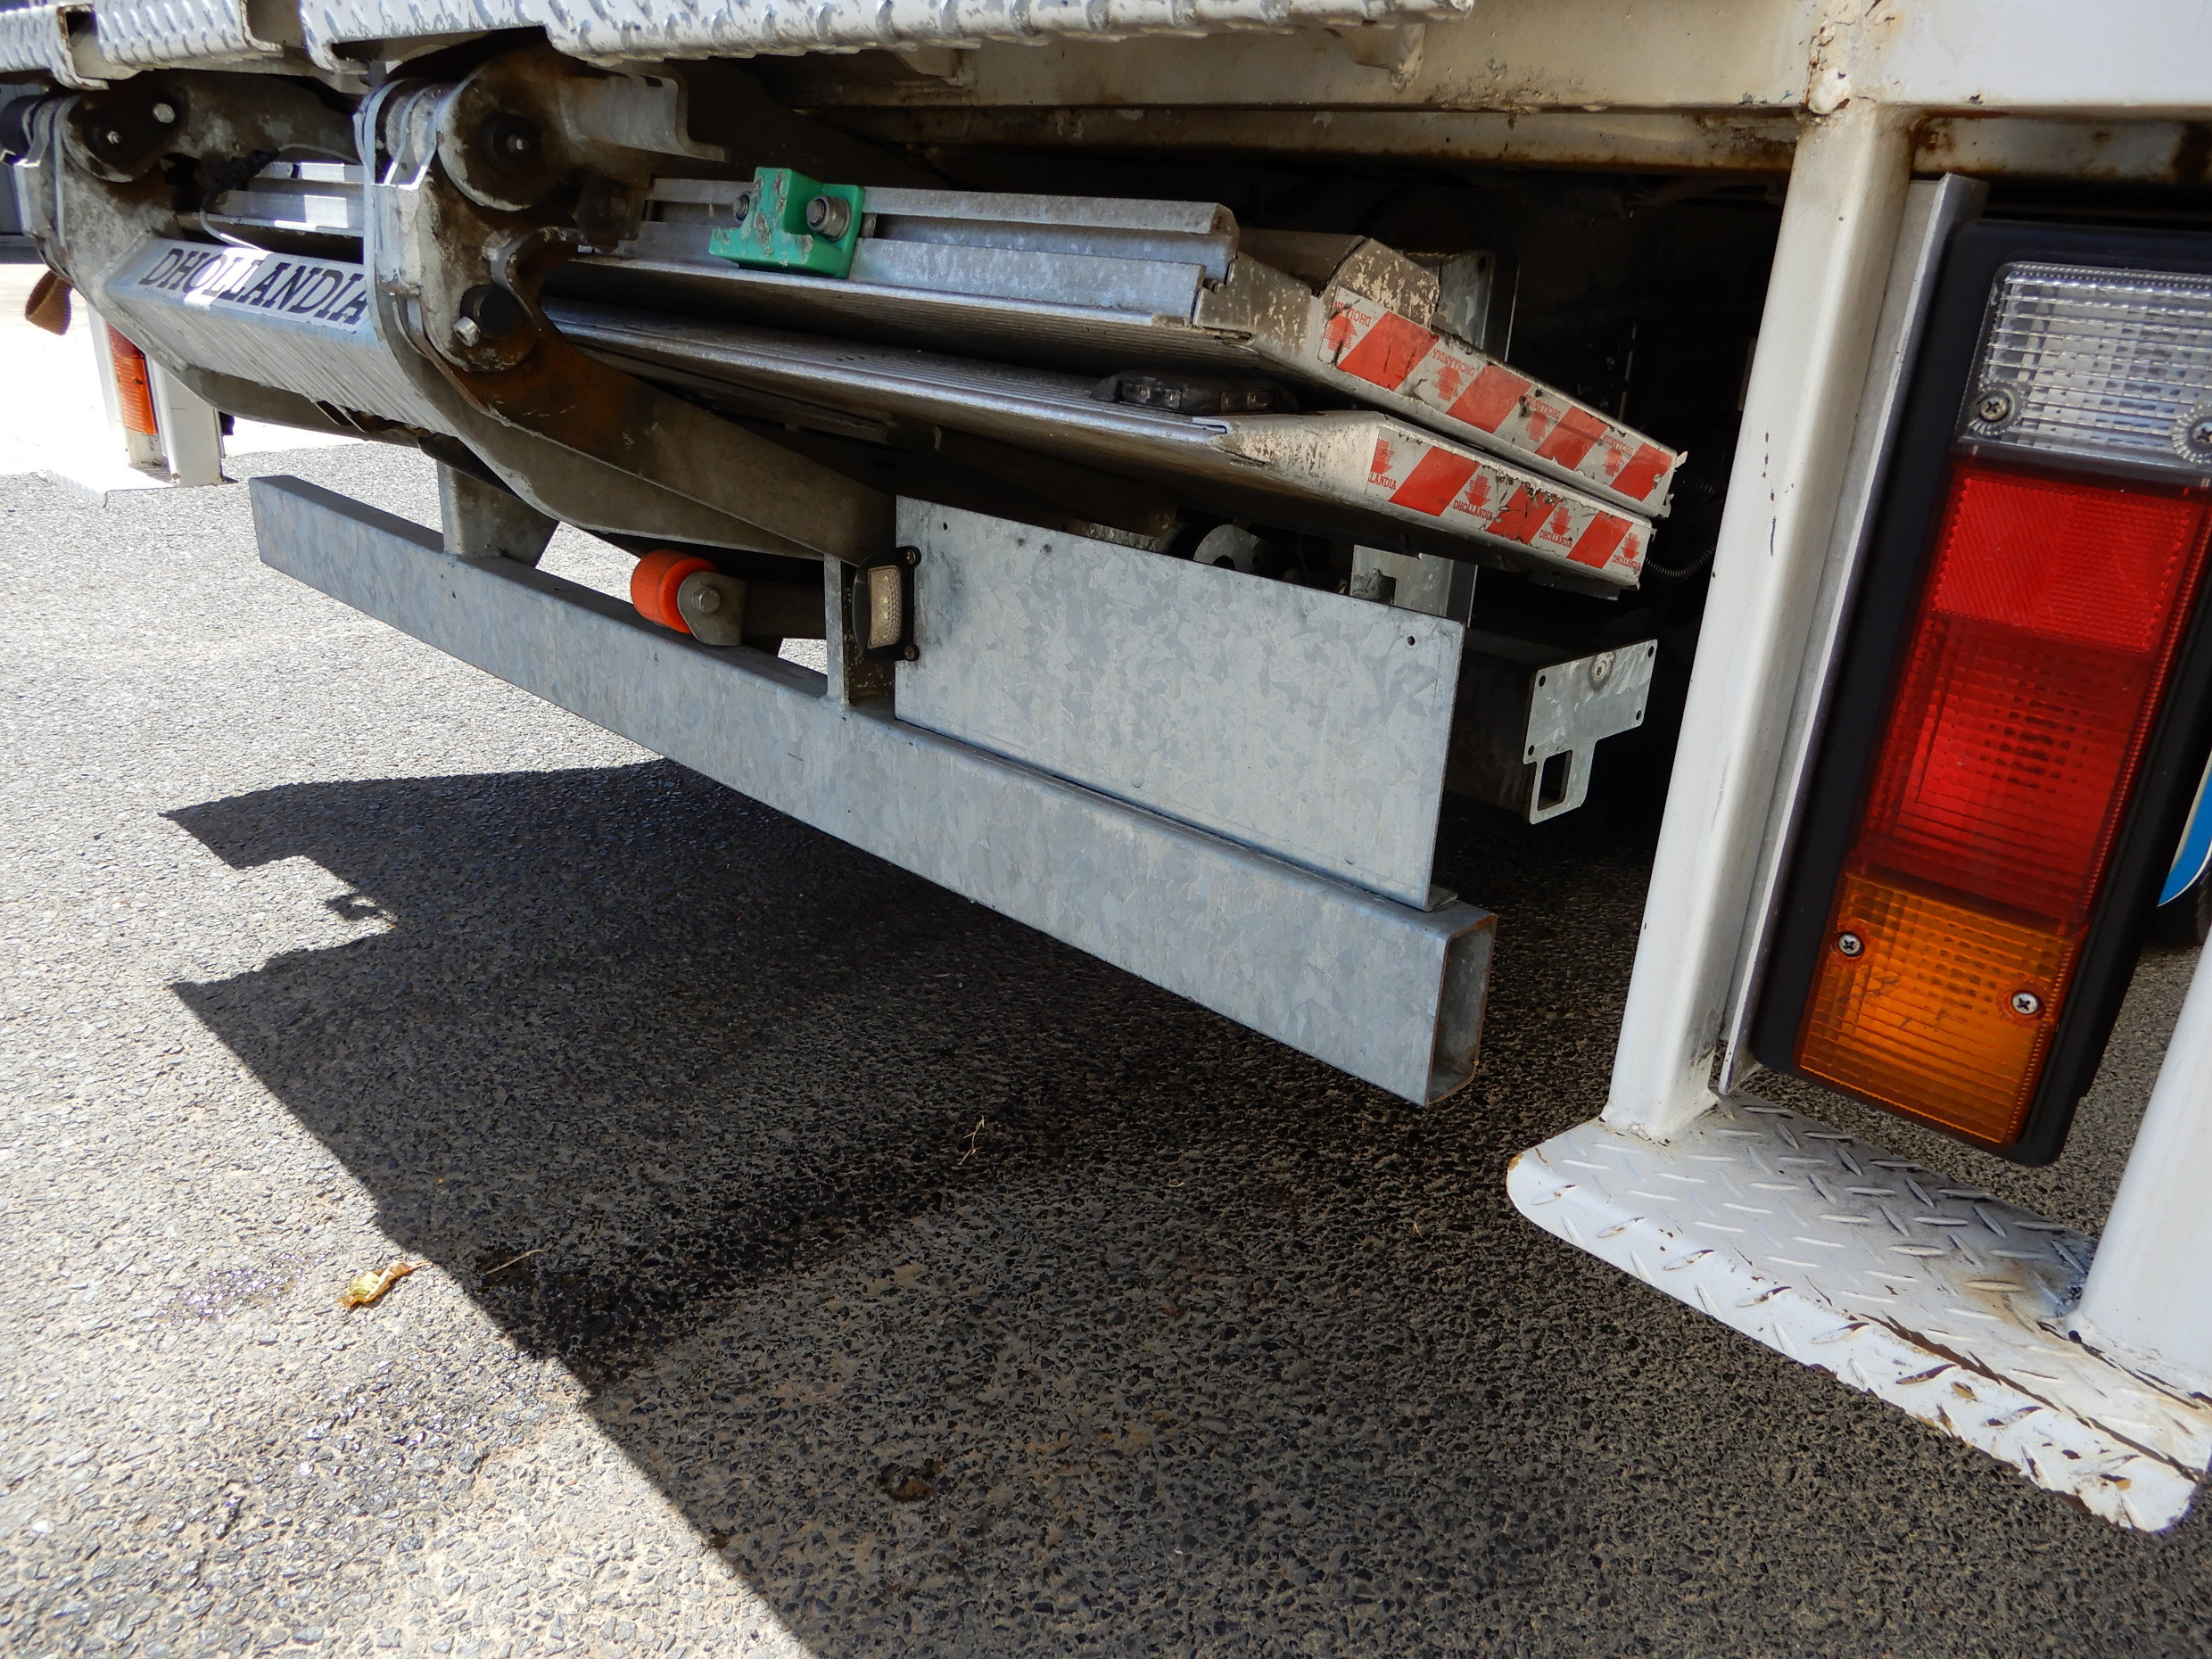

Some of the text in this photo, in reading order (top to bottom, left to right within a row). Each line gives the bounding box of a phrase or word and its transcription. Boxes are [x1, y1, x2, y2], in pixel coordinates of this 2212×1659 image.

[138, 248, 368, 326] DHOLLANDIA
[1432, 348, 1475, 377] DHOLLANDIA
[1453, 499, 1493, 521] DHOLLANDIA
[1539, 529, 1572, 549] DHOLLANDIA
